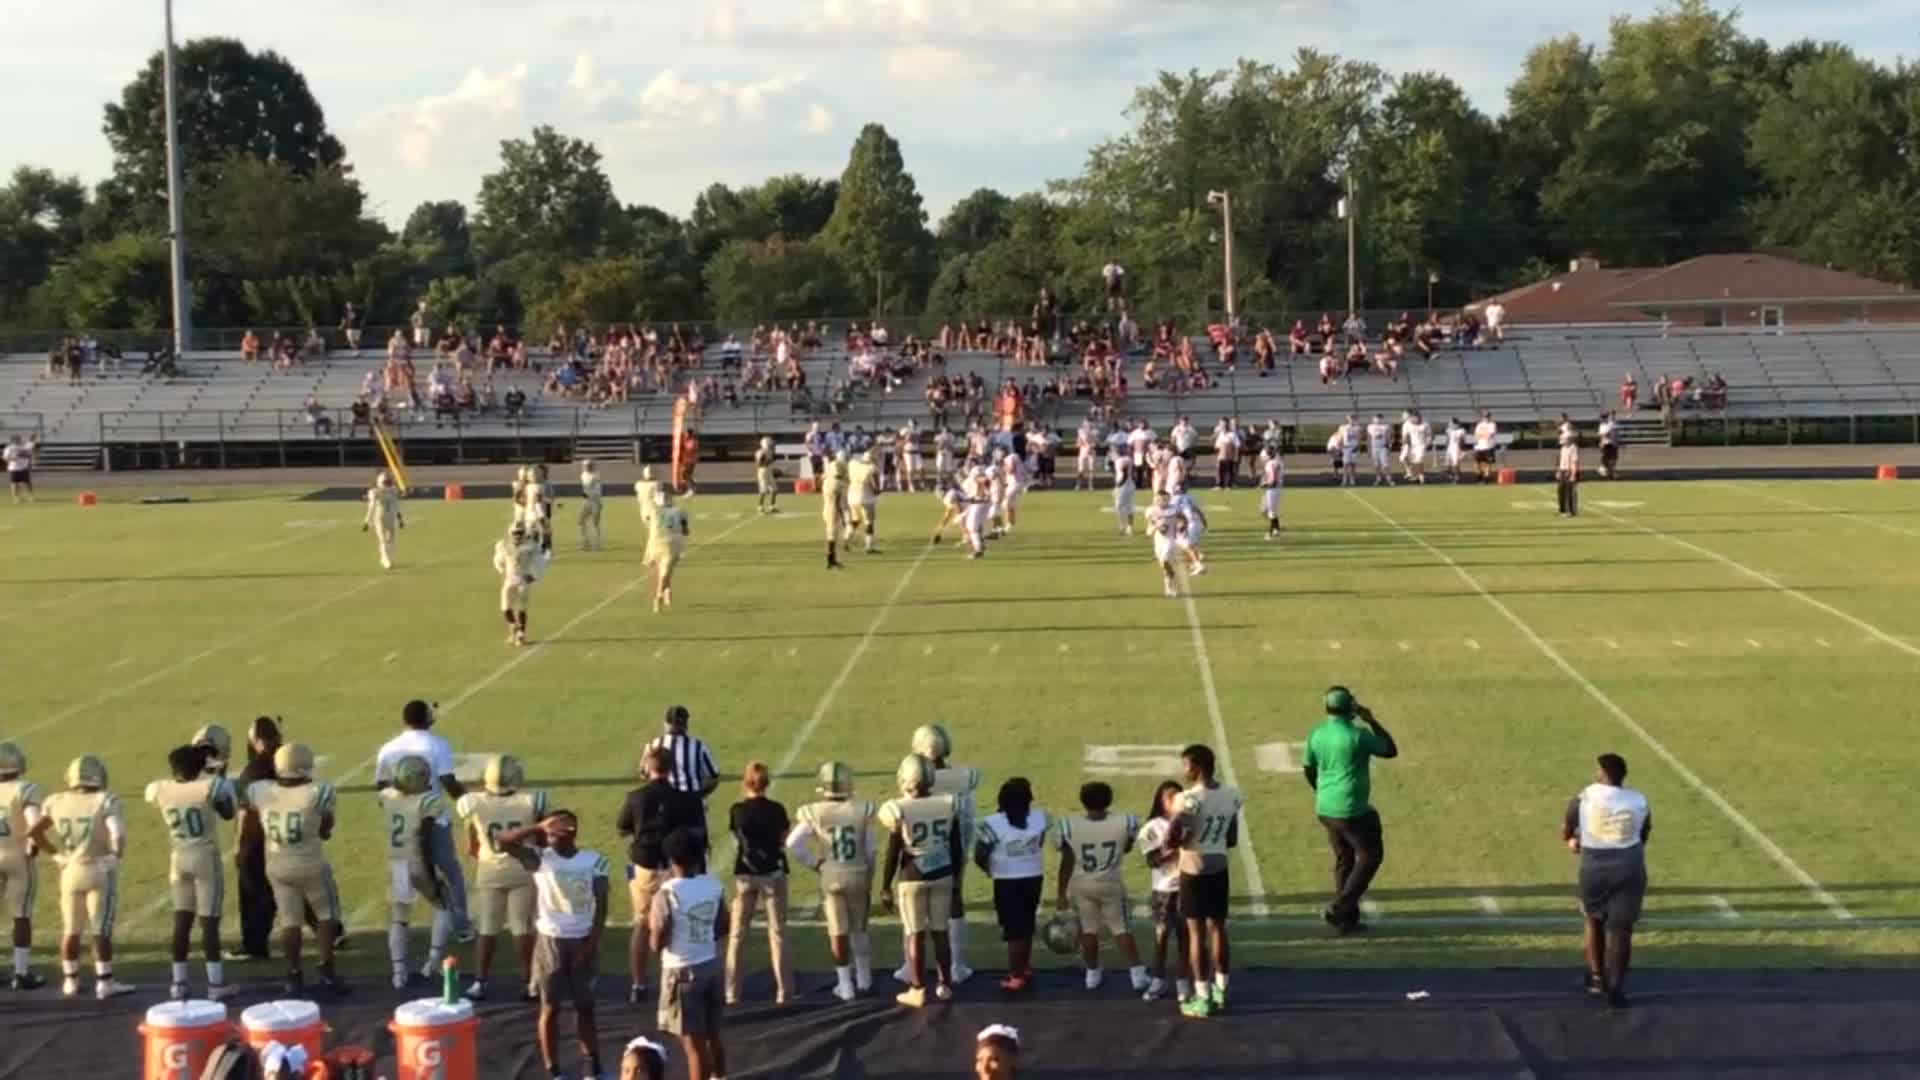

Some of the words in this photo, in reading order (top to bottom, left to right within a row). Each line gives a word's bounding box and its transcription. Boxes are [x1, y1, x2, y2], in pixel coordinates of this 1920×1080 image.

[59, 816, 94, 852] 27
[166, 807, 204, 838] 20
[391, 813, 406, 848] 2
[911, 819, 949, 850] 25
[827, 826, 856, 860] 16
[1082, 841, 1117, 873] 57
